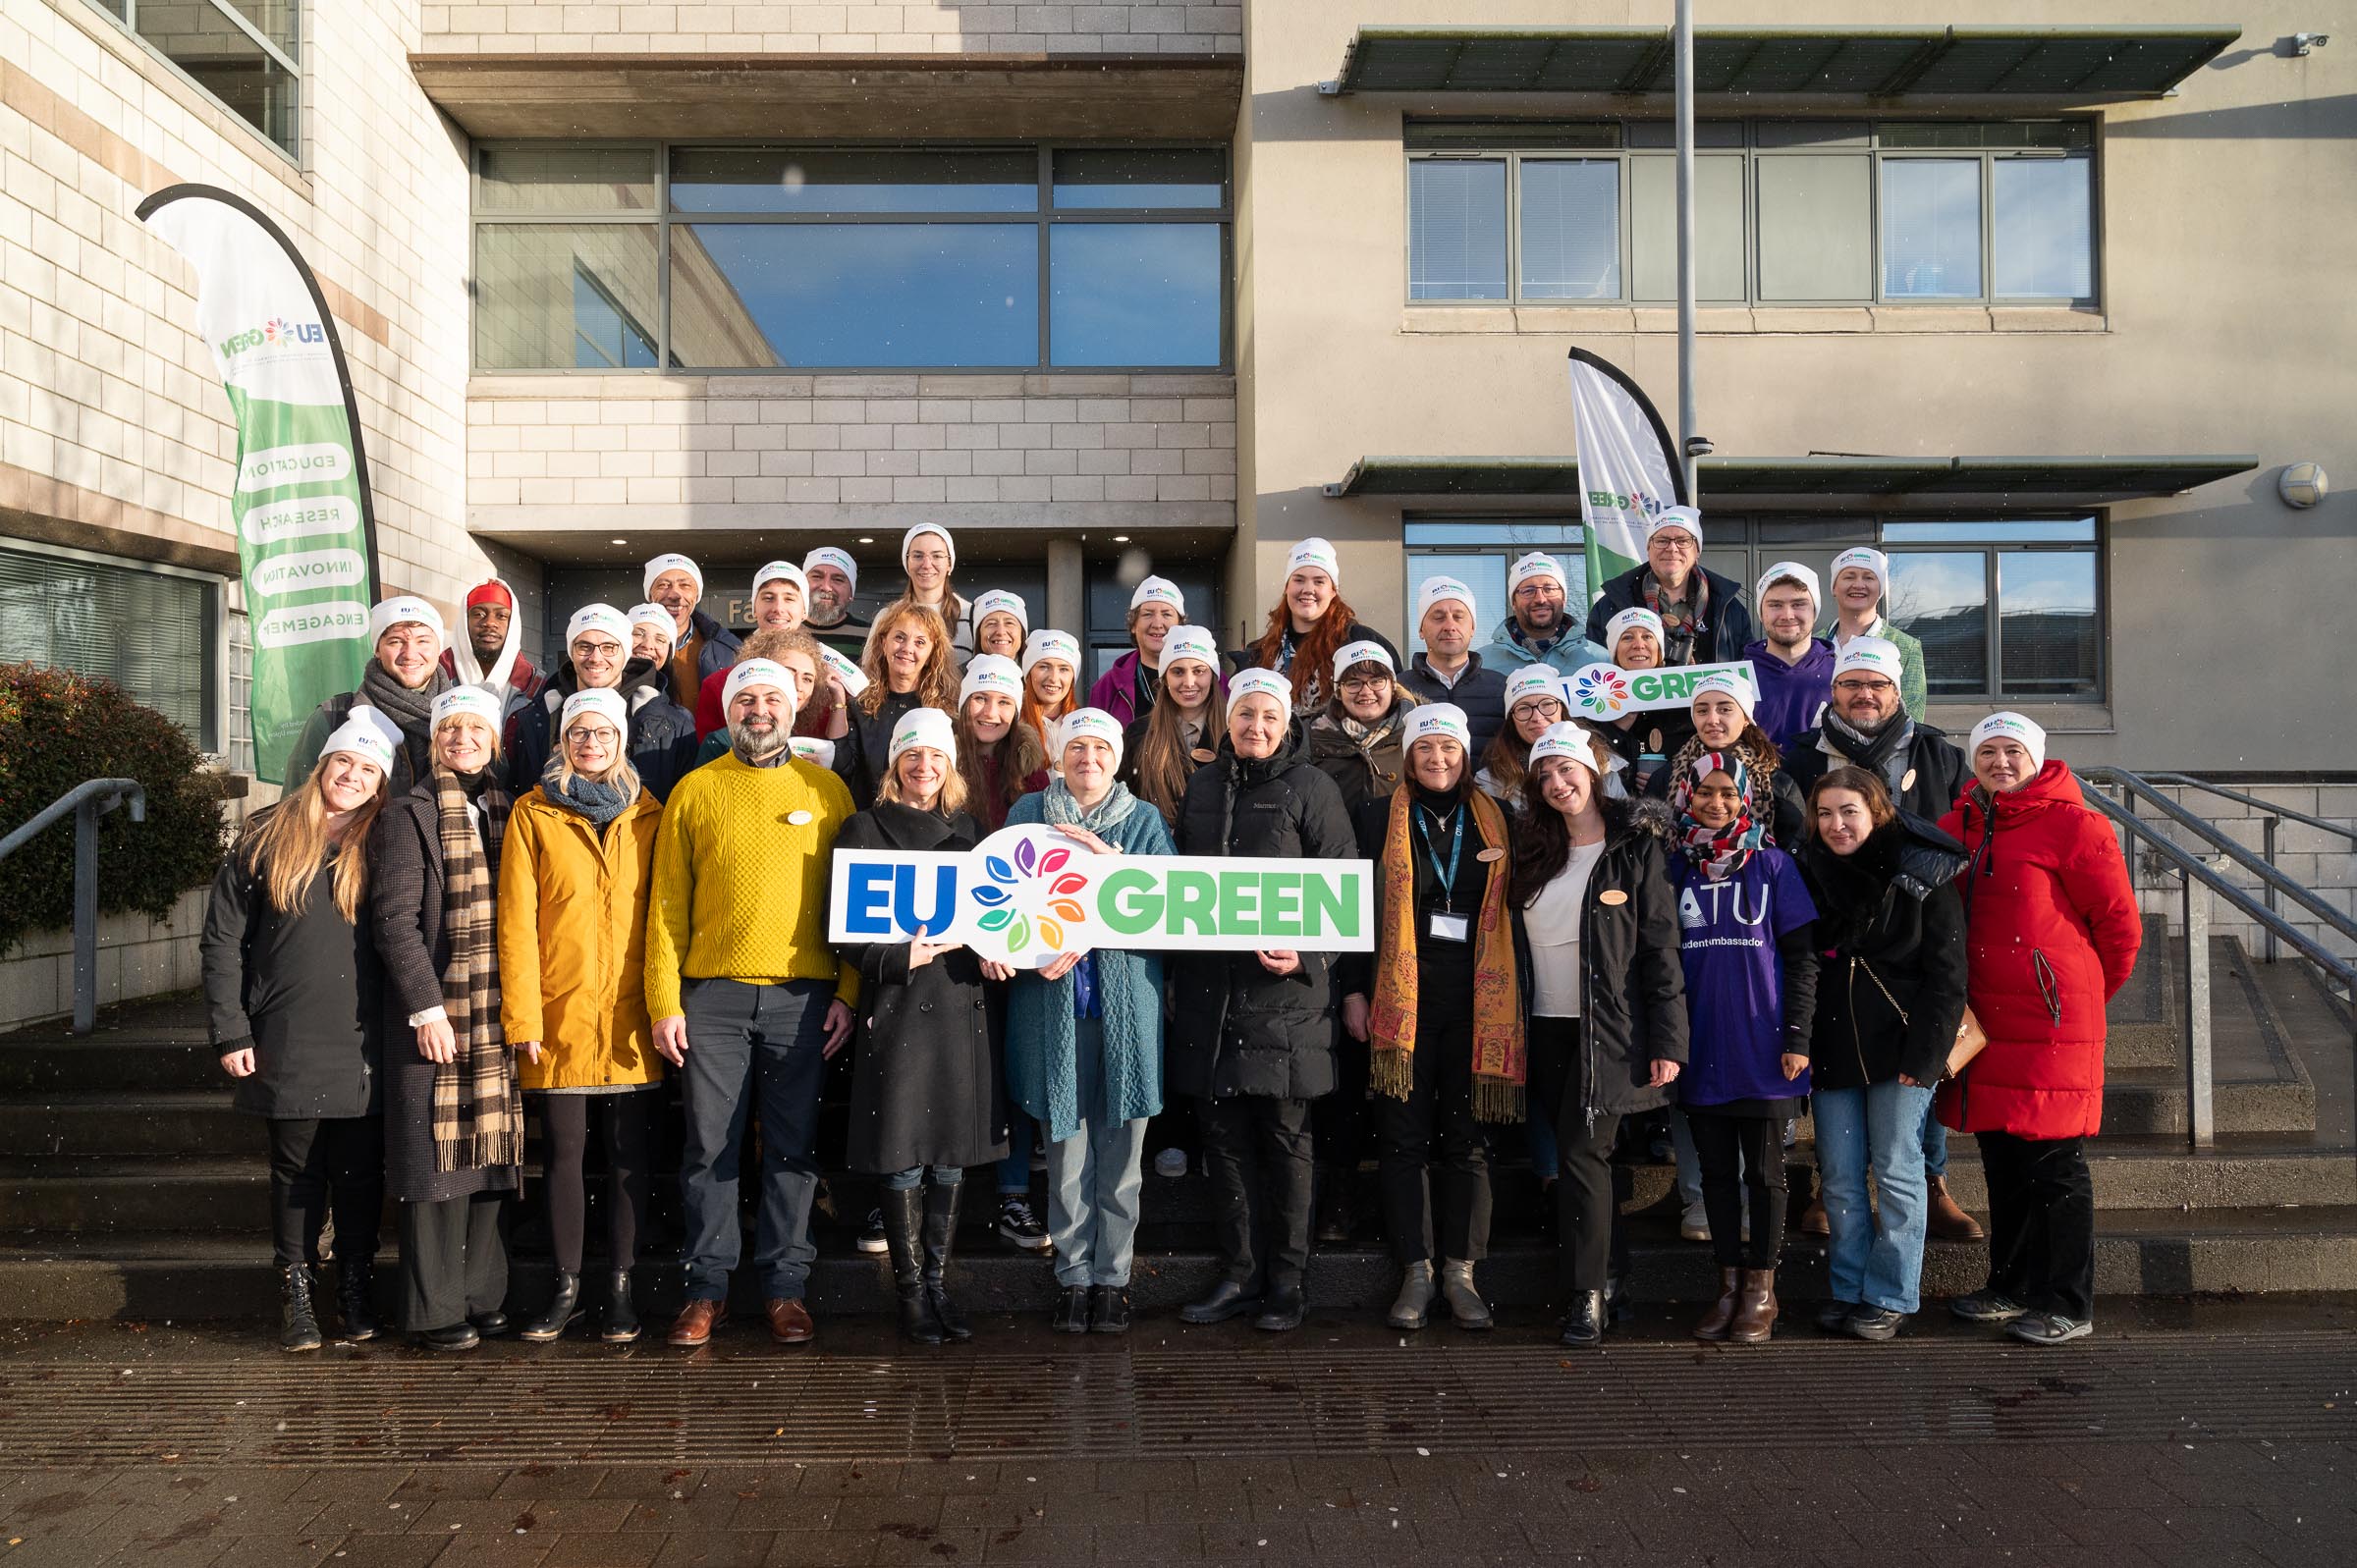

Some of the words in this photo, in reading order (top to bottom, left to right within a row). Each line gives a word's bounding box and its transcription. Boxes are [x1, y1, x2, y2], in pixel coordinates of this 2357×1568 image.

[1631, 668, 1749, 702] GRE
[846, 862, 958, 938] EU
[1097, 868, 1360, 938] GREEN
[1679, 882, 1769, 929] ATU
